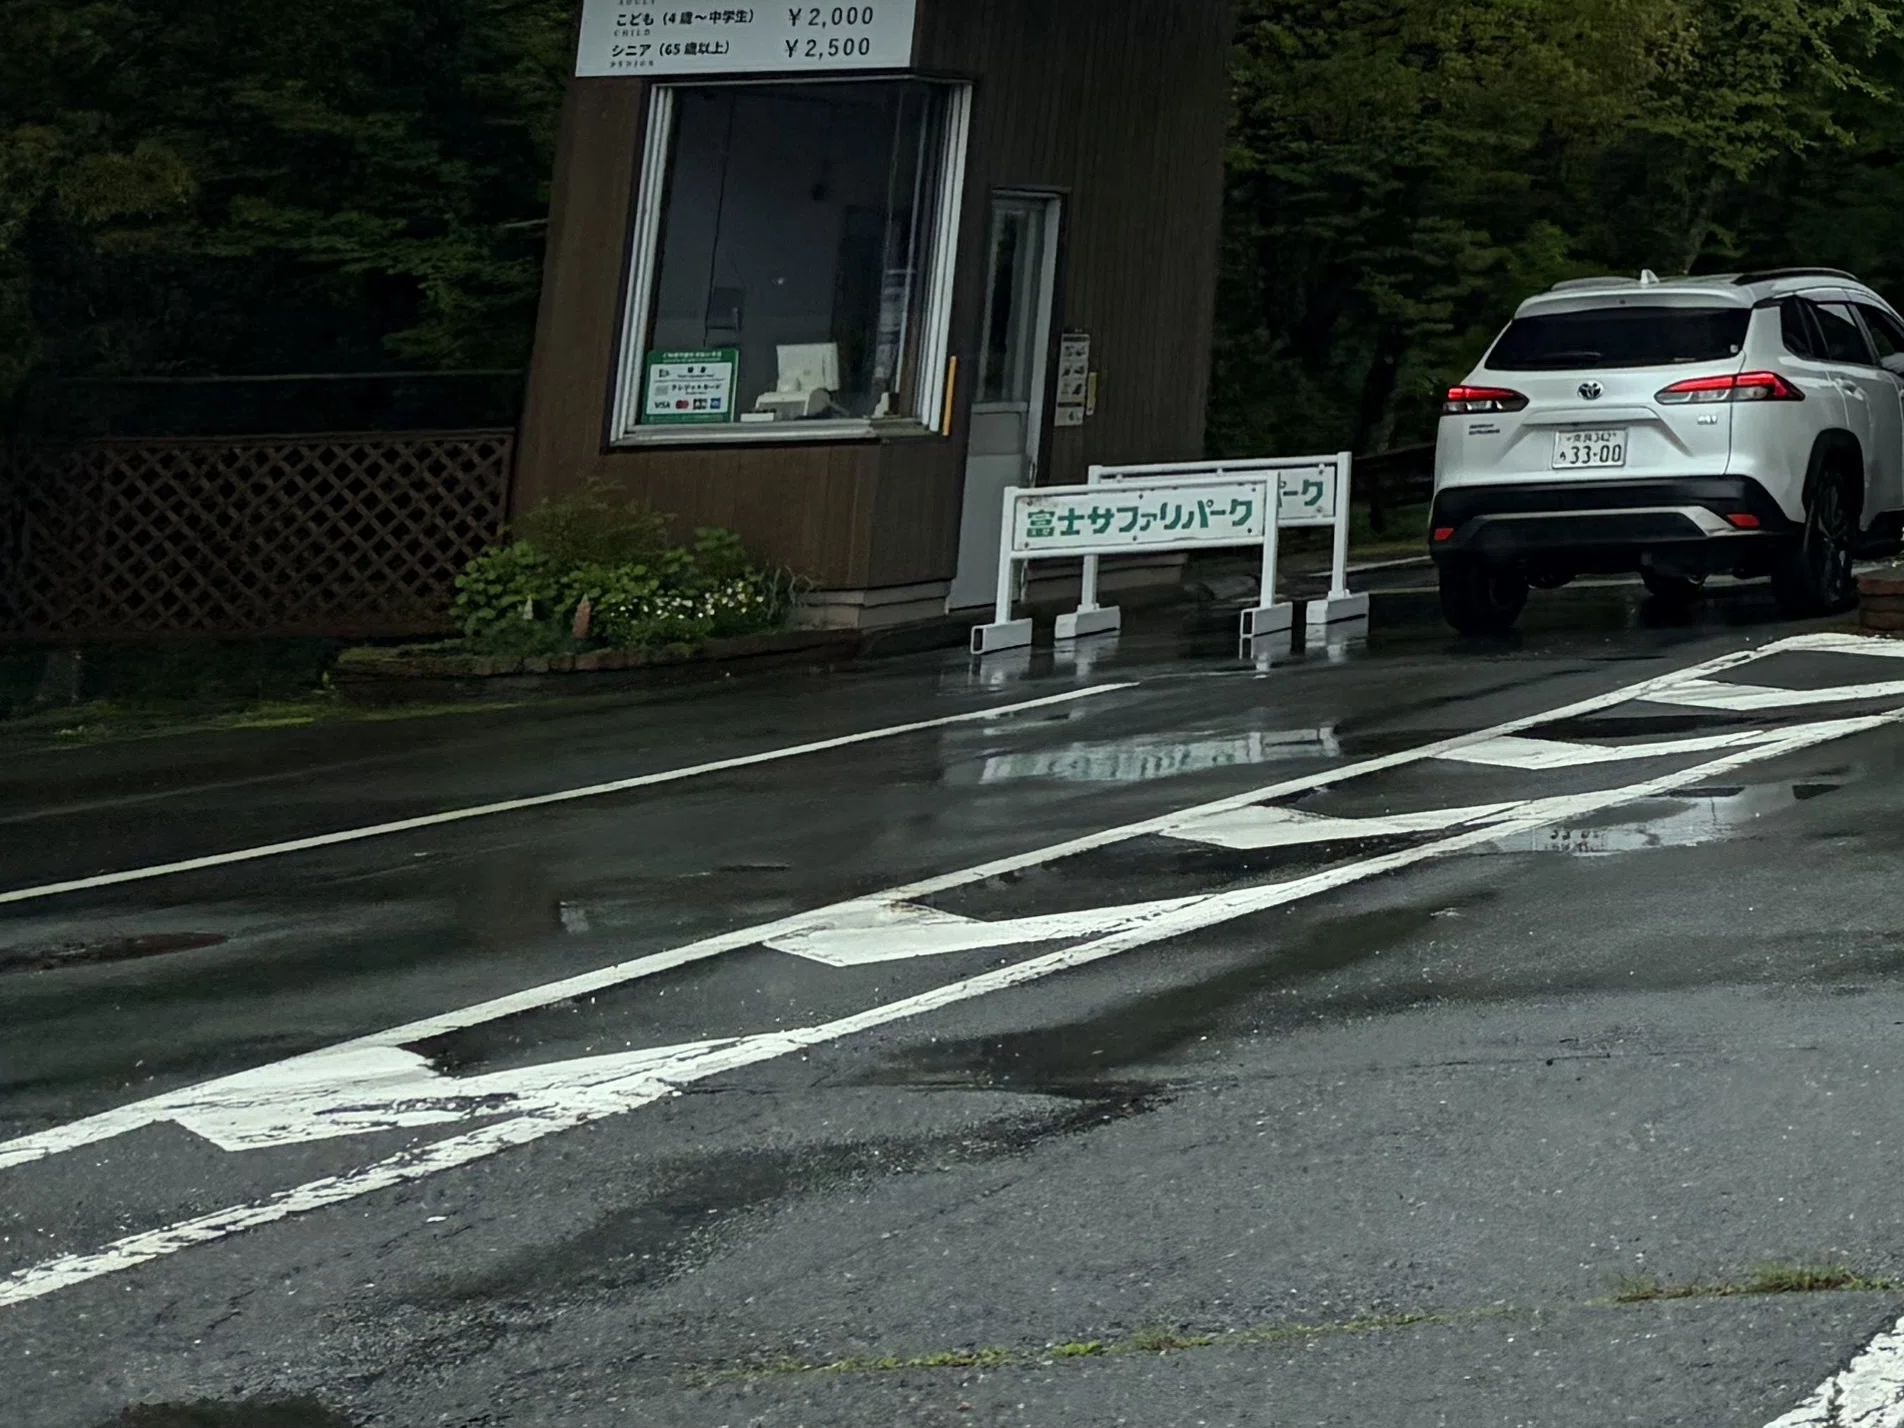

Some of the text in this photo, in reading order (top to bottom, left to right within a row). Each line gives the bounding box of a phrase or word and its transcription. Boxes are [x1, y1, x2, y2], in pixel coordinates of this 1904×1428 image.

[1026, 498, 1254, 538] 富士サファリパーク
